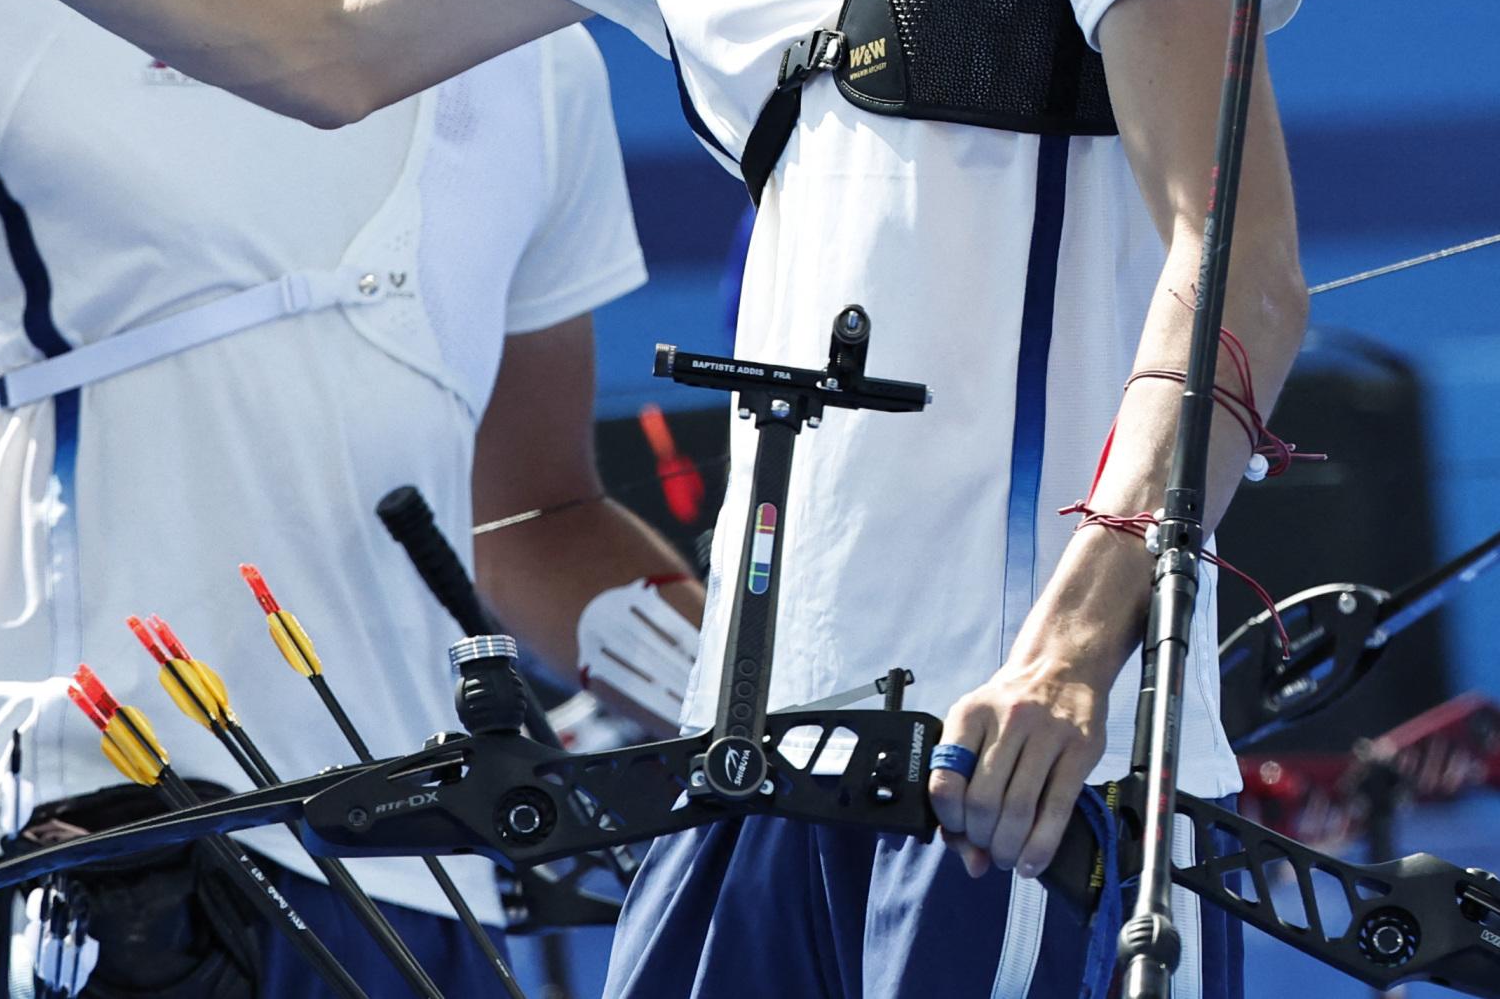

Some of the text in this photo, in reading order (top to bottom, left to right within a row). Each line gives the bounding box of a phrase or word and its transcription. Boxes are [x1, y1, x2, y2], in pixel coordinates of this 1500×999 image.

[849, 37, 886, 69] W&W
[692, 360, 792, 381] BAPTISTE ADDIS FRA
[733, 749, 752, 787] SHIBUYA
